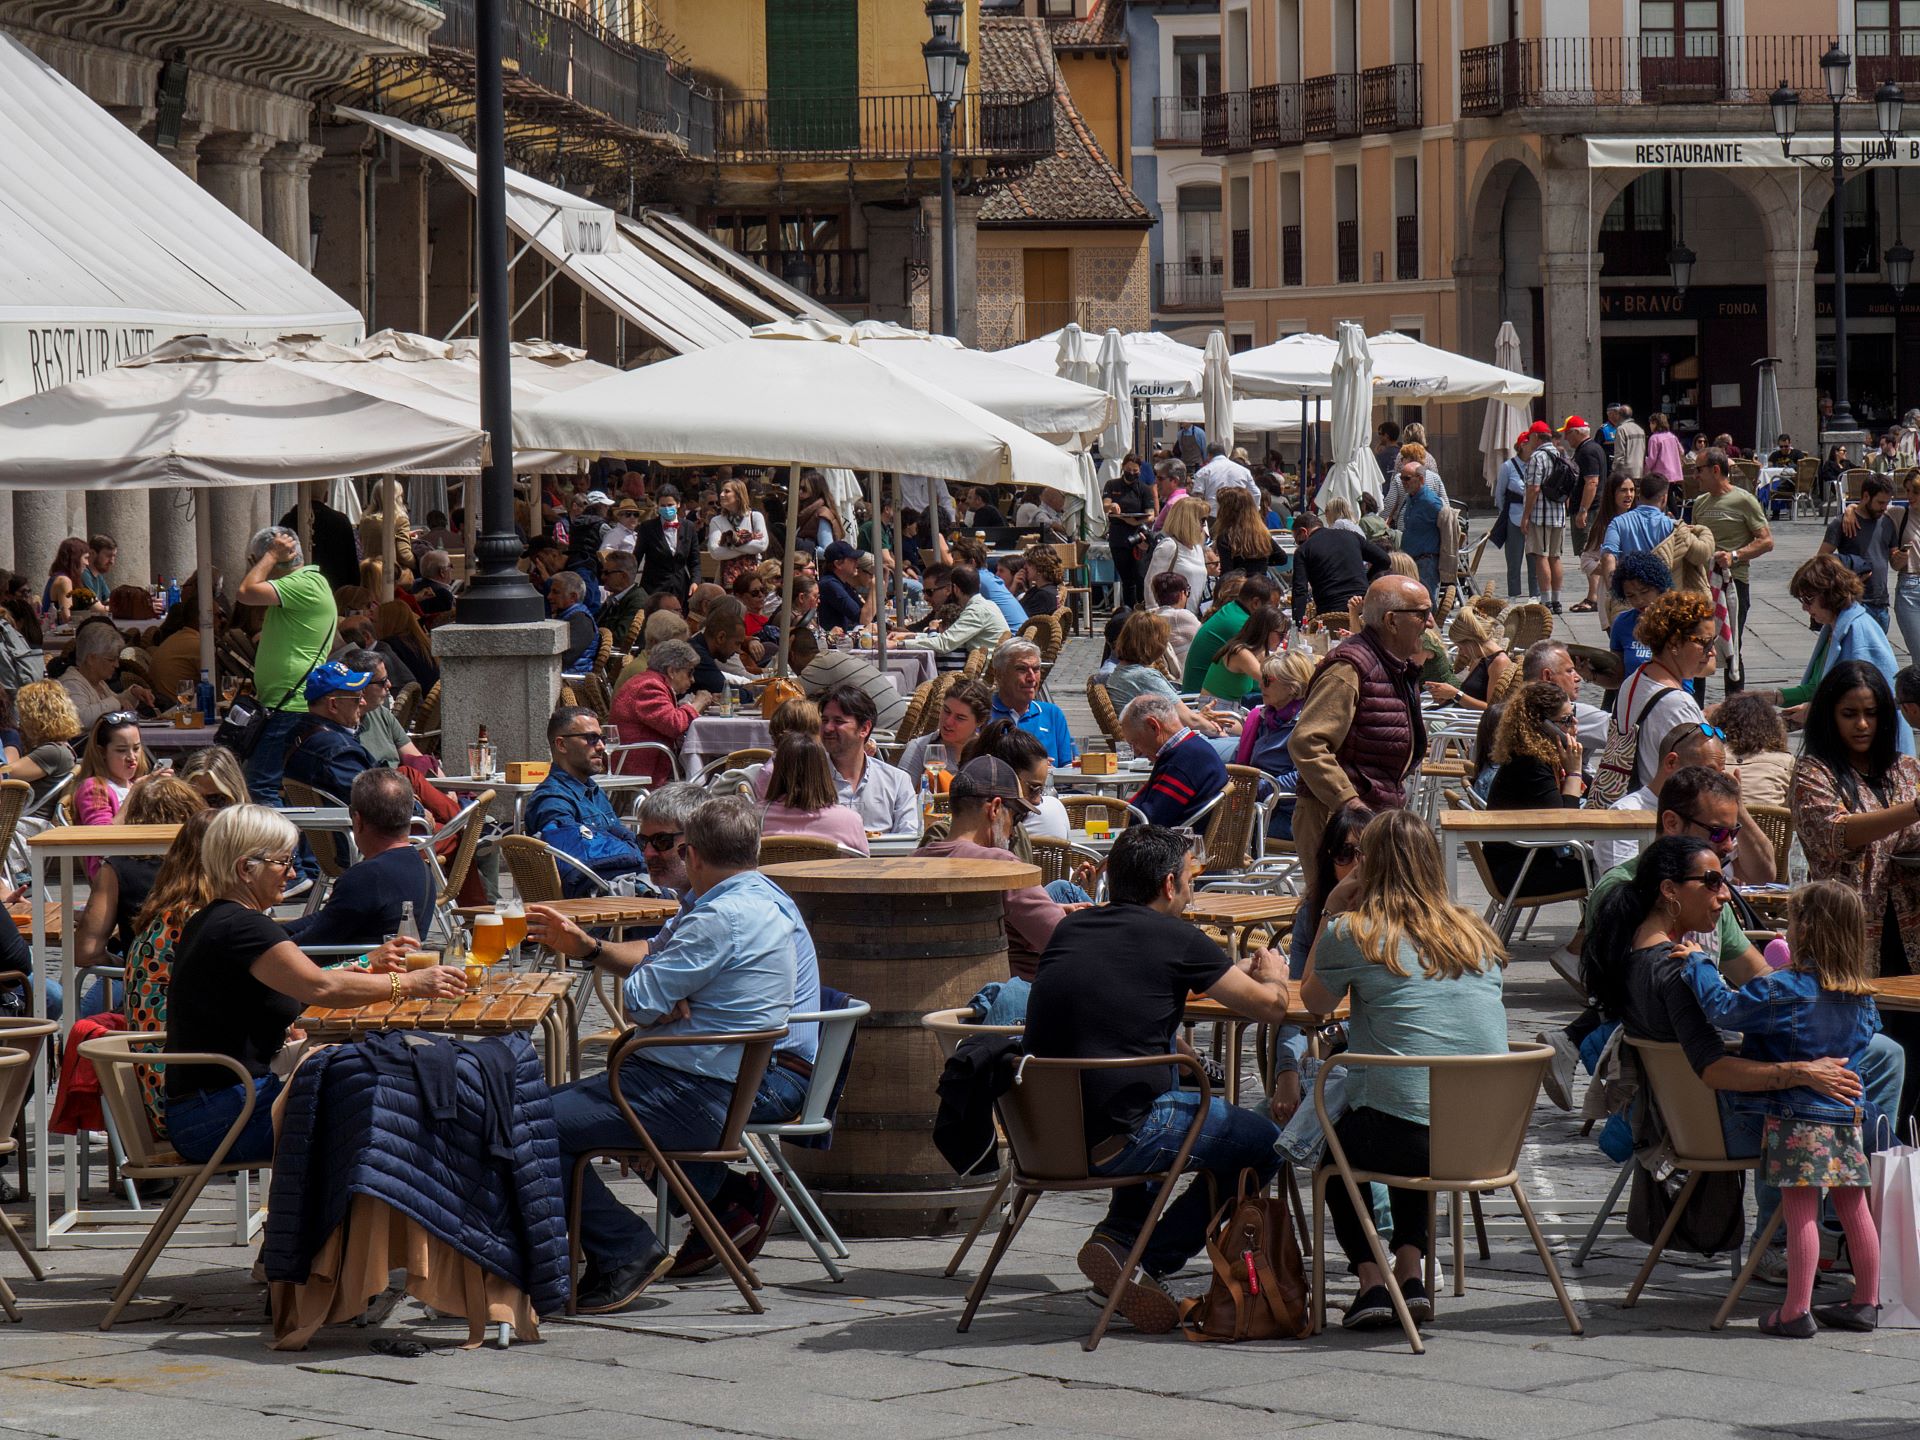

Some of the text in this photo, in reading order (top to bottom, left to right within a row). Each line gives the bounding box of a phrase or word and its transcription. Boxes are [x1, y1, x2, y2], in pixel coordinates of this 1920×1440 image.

[1636, 143, 1743, 163] RESTAURANTE
[1861, 141, 1897, 160] JUAN
[1624, 295, 1682, 313] BRAVO
[1719, 303, 1759, 315] FONDA
